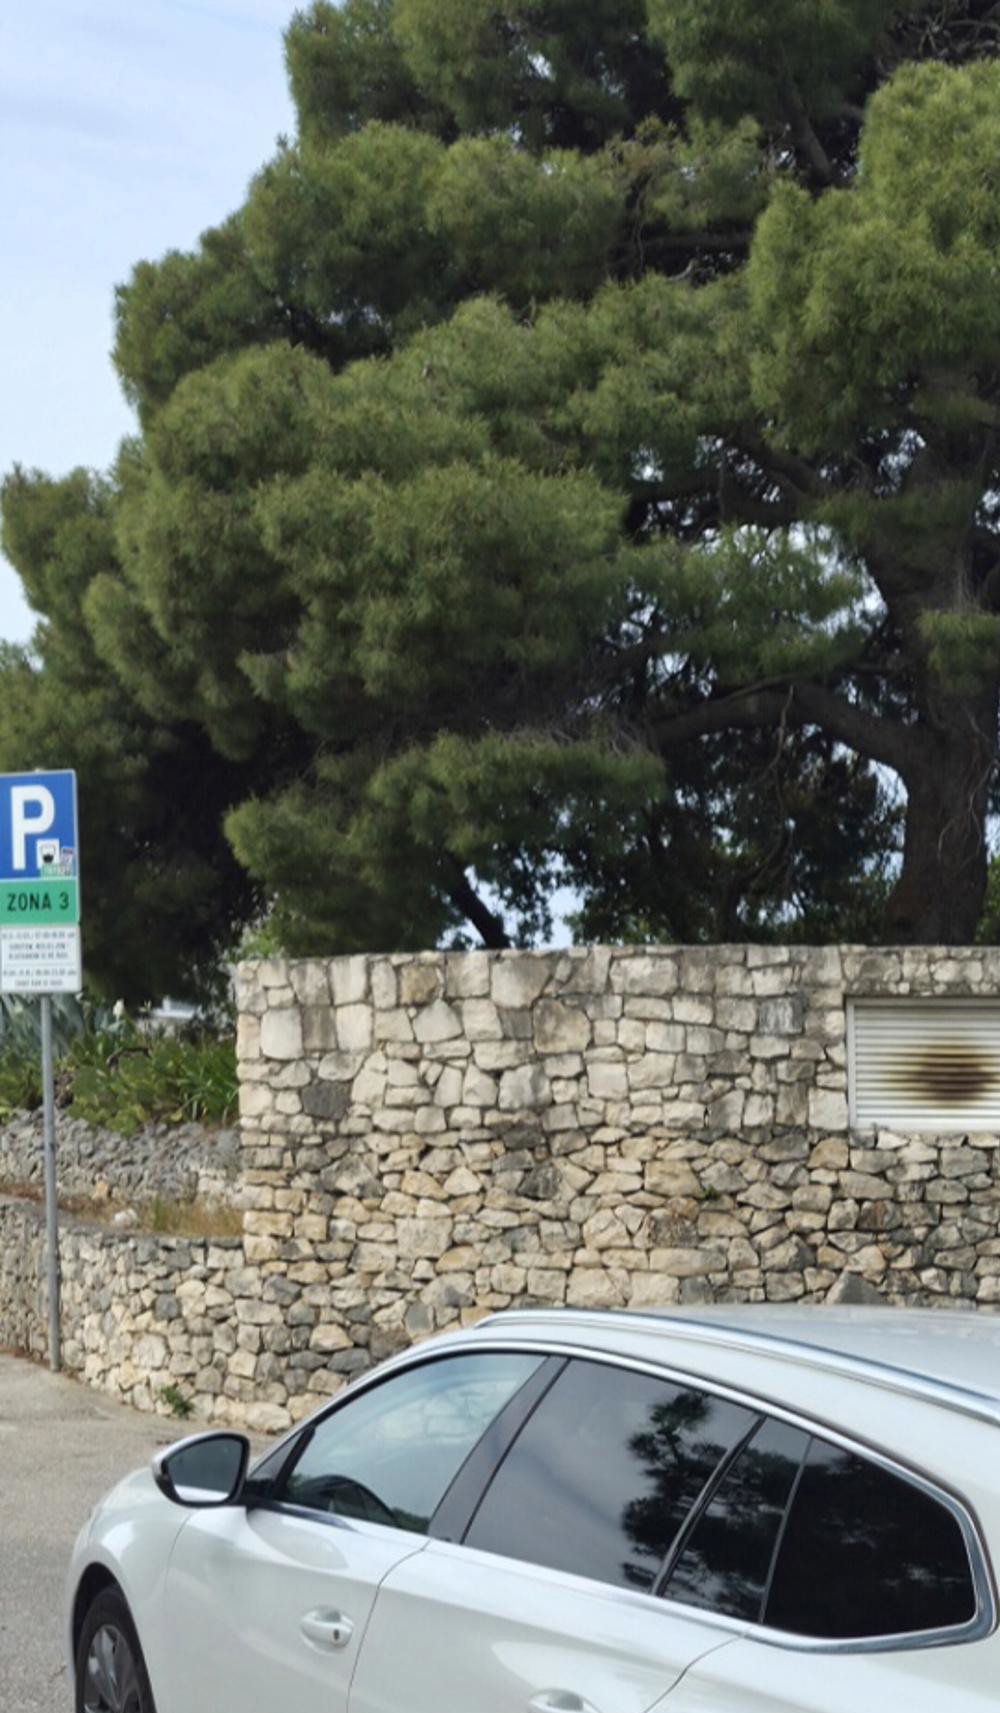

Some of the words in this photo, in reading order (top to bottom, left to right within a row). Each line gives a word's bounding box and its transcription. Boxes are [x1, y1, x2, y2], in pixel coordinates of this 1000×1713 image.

[11, 785, 55, 870] P
[7, 892, 52, 912] ZONA
[59, 891, 69, 910] 3
